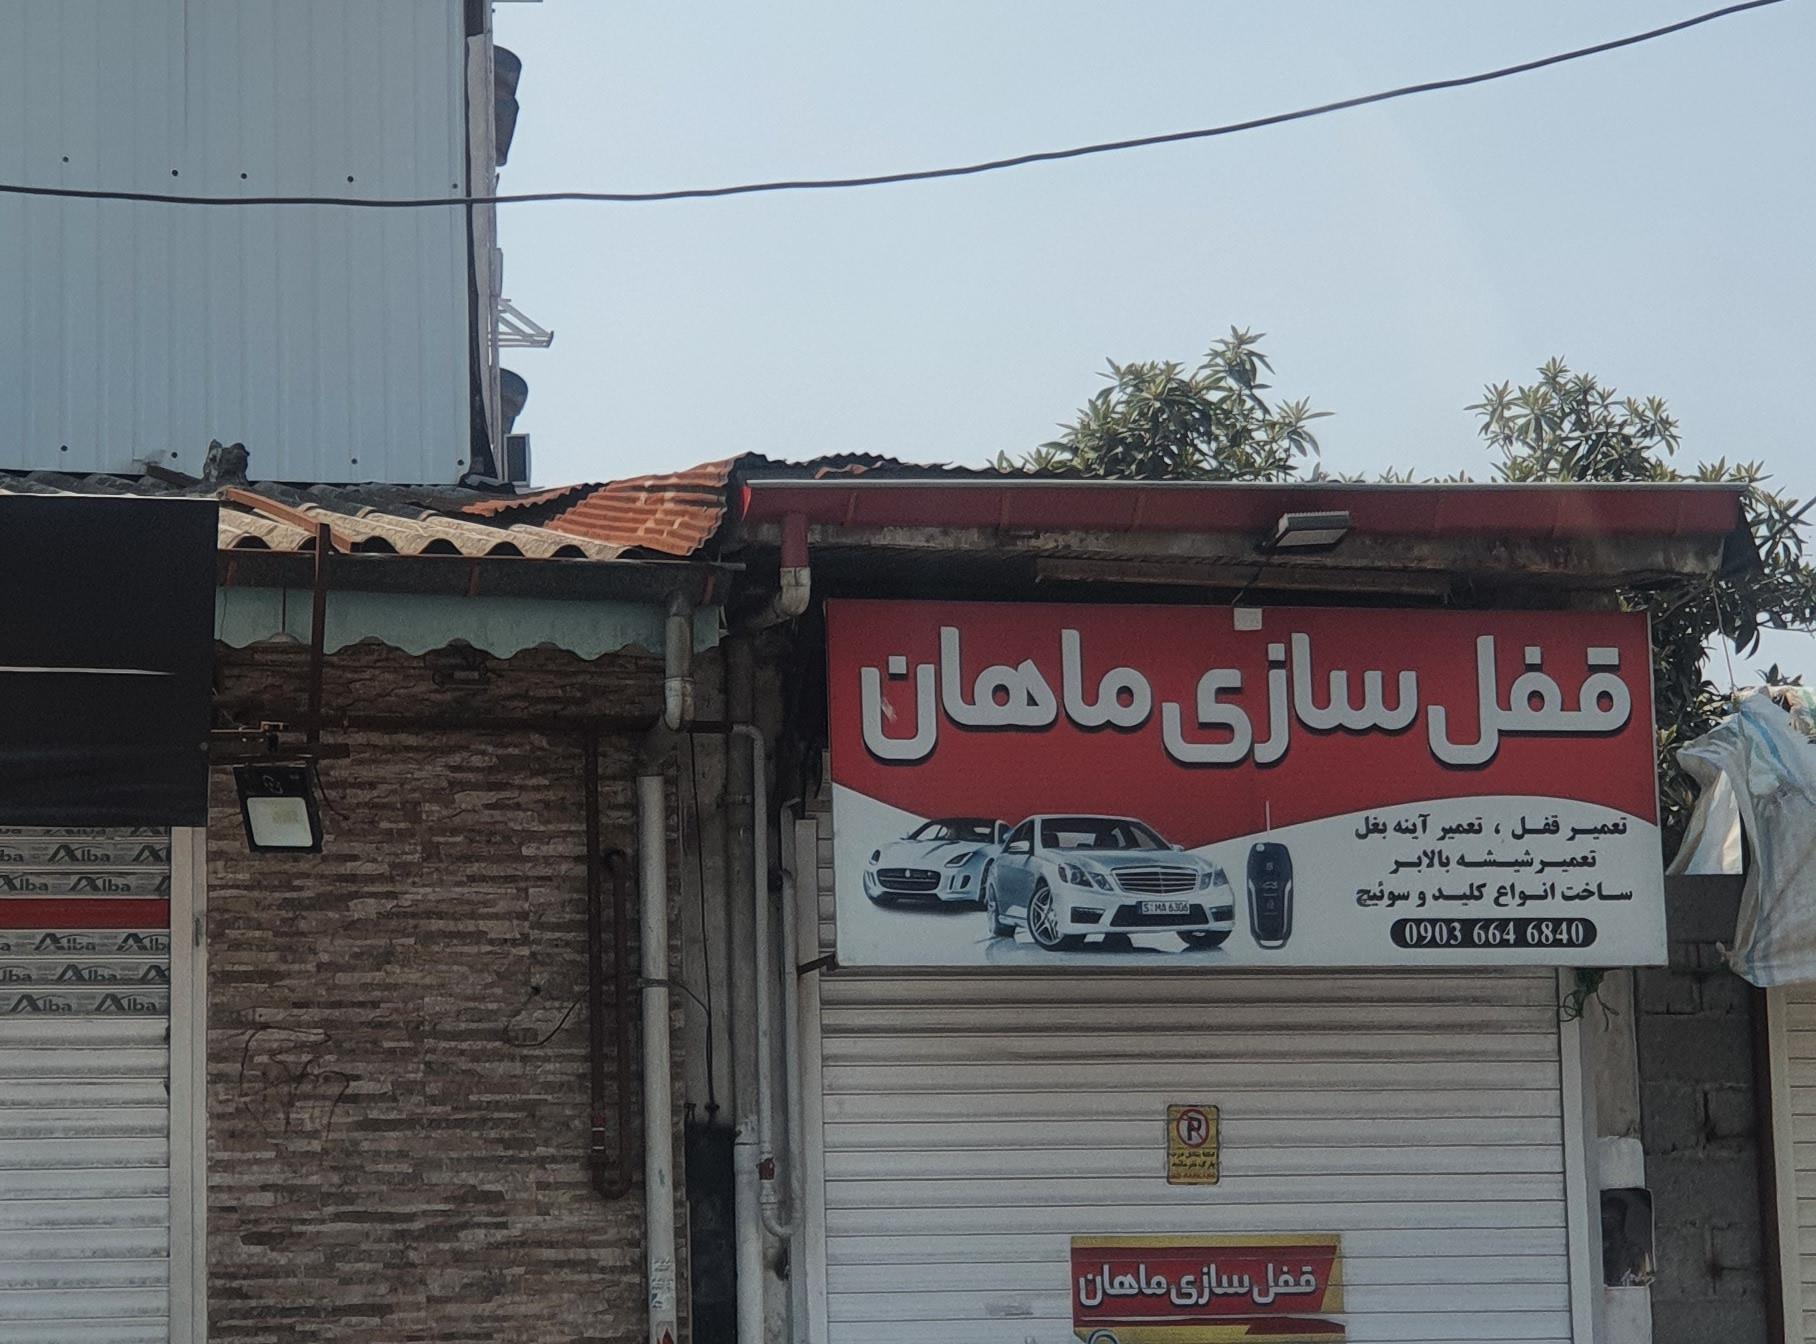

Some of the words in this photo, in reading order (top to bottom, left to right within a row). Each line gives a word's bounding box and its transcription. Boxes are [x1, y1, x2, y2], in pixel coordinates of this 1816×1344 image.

[860, 625, 1152, 761] ماهان
[1162, 632, 1418, 765] سازی
[1427, 634, 1632, 766] قفل
[1354, 815, 1388, 840] بغل
[1392, 812, 1431, 840] آینه
[1436, 816, 1483, 841] تعمیر
[1511, 814, 1561, 841] قفل
[1566, 816, 1628, 841] تعمیر
[1389, 849, 1451, 874] بالابر
[1456, 849, 1534, 873] شیشه
[1534, 849, 1597, 874] تعمیر
[1416, 889, 1427, 907] و
[1431, 882, 1488, 906] کلید
[1493, 882, 1556, 907] انواع
[1560, 882, 1633, 902] ساخت
[115, 932, 169, 952] Alb
[1405, 921, 1462, 945] 0903
[1472, 921, 1516, 945] 664
[1526, 920, 1584, 945] 6840
[1079, 1263, 1168, 1306] ماهان
[1170, 1262, 1250, 1306] سازی
[1252, 1263, 1317, 1304] قفل
